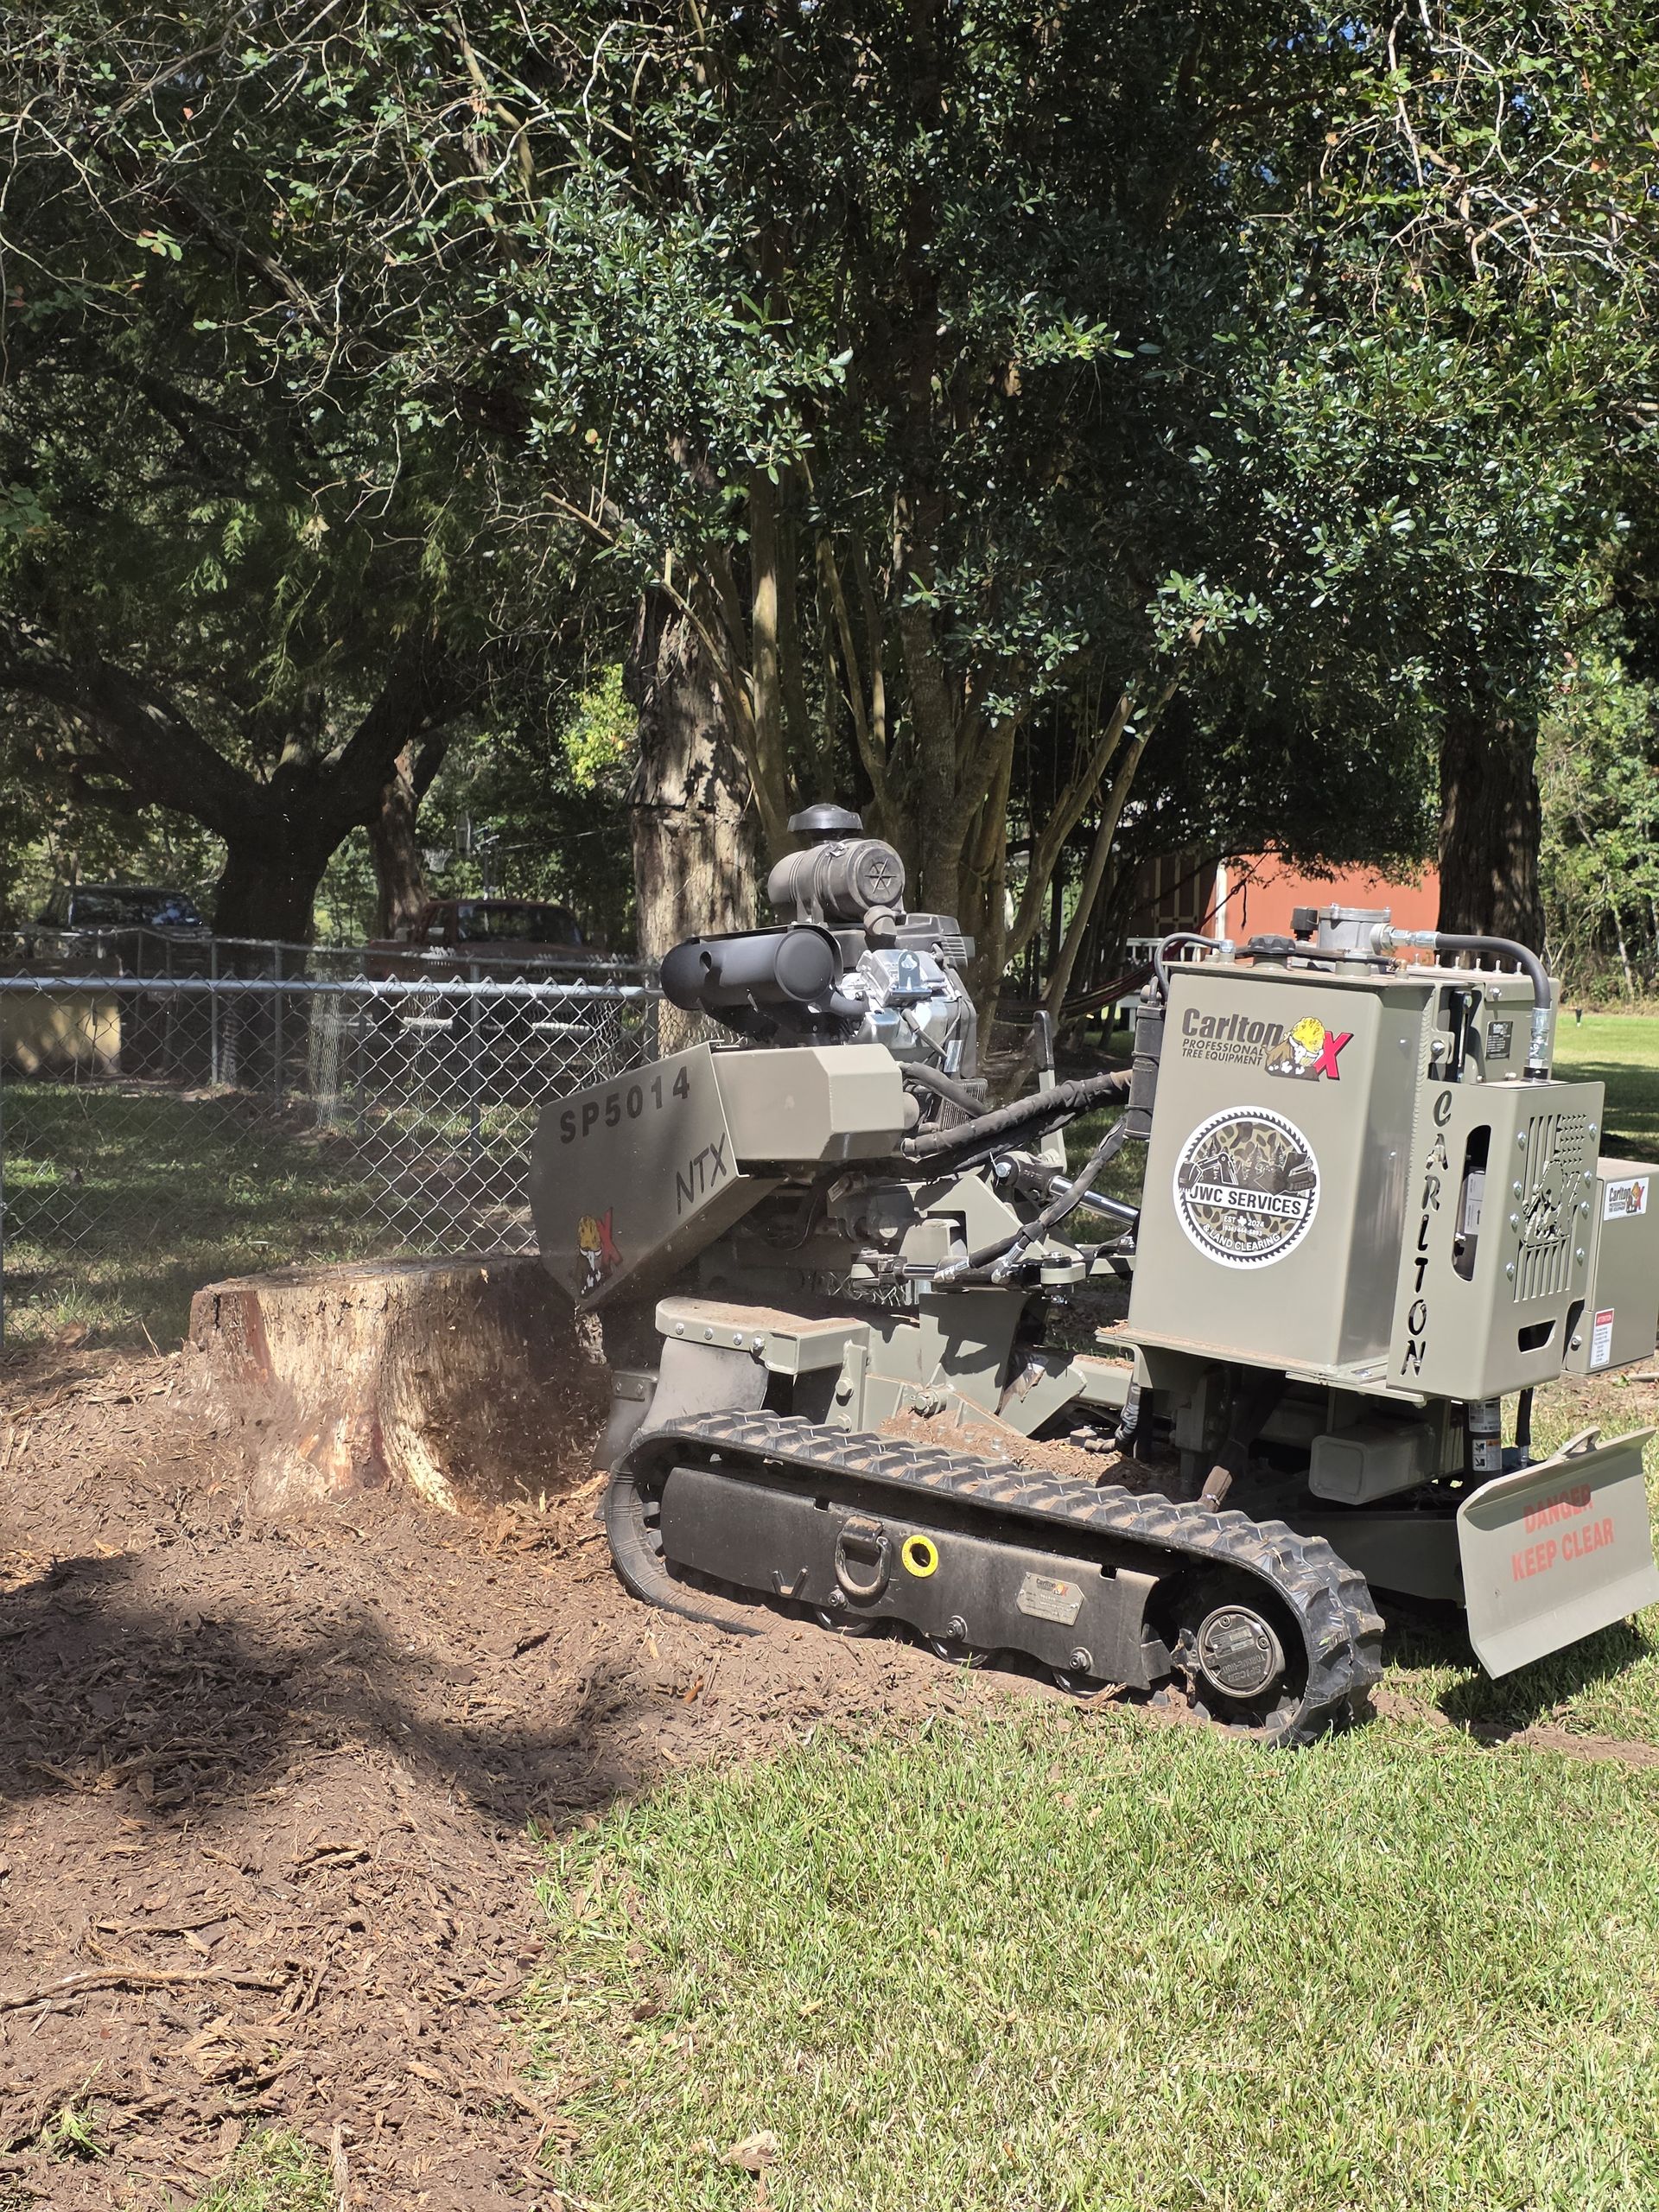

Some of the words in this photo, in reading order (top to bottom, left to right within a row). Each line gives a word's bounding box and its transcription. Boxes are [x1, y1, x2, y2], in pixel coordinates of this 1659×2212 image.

[1182, 1008, 1284, 1046] Carlton
[1182, 1039, 1263, 1056] PROFESSIONAL
[1182, 1048, 1203, 1059] TREE
[1205, 1050, 1262, 1066] EQUIPMENT
[560, 1066, 690, 1144] SP5014
[677, 1133, 727, 1215] NTX
[1189, 1185, 1223, 1203] JWC
[1228, 1191, 1301, 1215] SERVICES
[1209, 1229, 1233, 1248] LAND
[1235, 1233, 1281, 1251] CLEARING
[1400, 1090, 1452, 1377] CARLTON
[1522, 1484, 1593, 1534] DANGER
[1511, 1540, 1557, 1582] KEEP
[1561, 1517, 1615, 1561] CLEAR
[1228, 1665, 1262, 1682] SPICER
